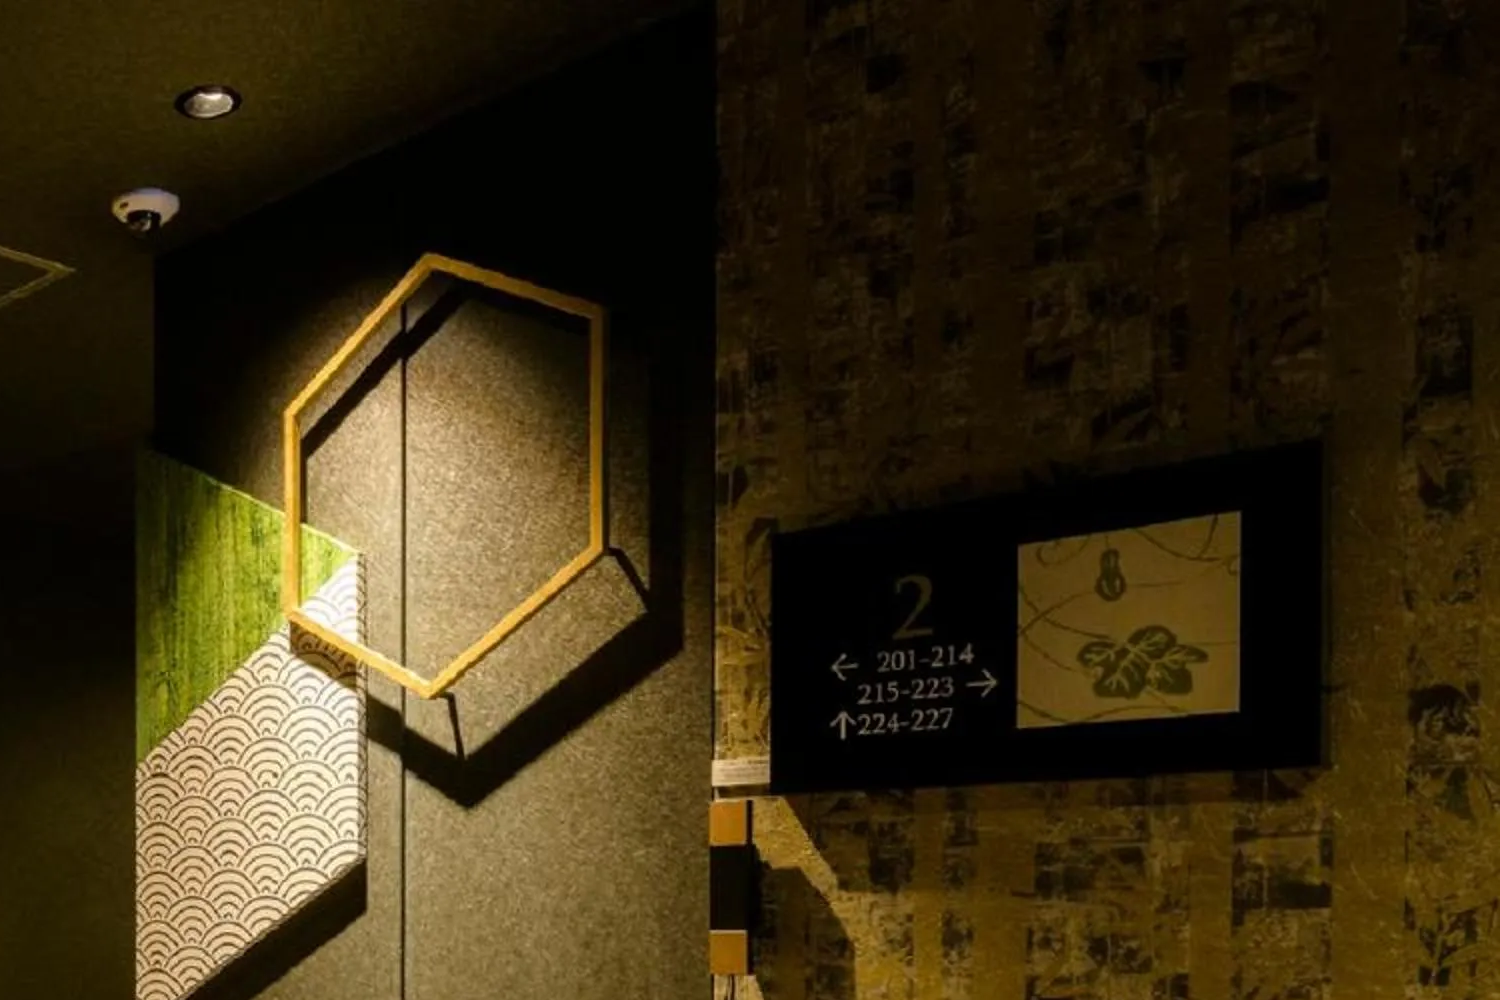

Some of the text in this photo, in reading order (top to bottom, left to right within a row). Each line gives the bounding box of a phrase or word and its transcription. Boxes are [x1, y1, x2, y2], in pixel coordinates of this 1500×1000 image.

[893, 574, 933, 640] 2
[877, 643, 975, 672] 201-214
[857, 676, 955, 705] 215-223
[857, 707, 954, 735] 224-227
